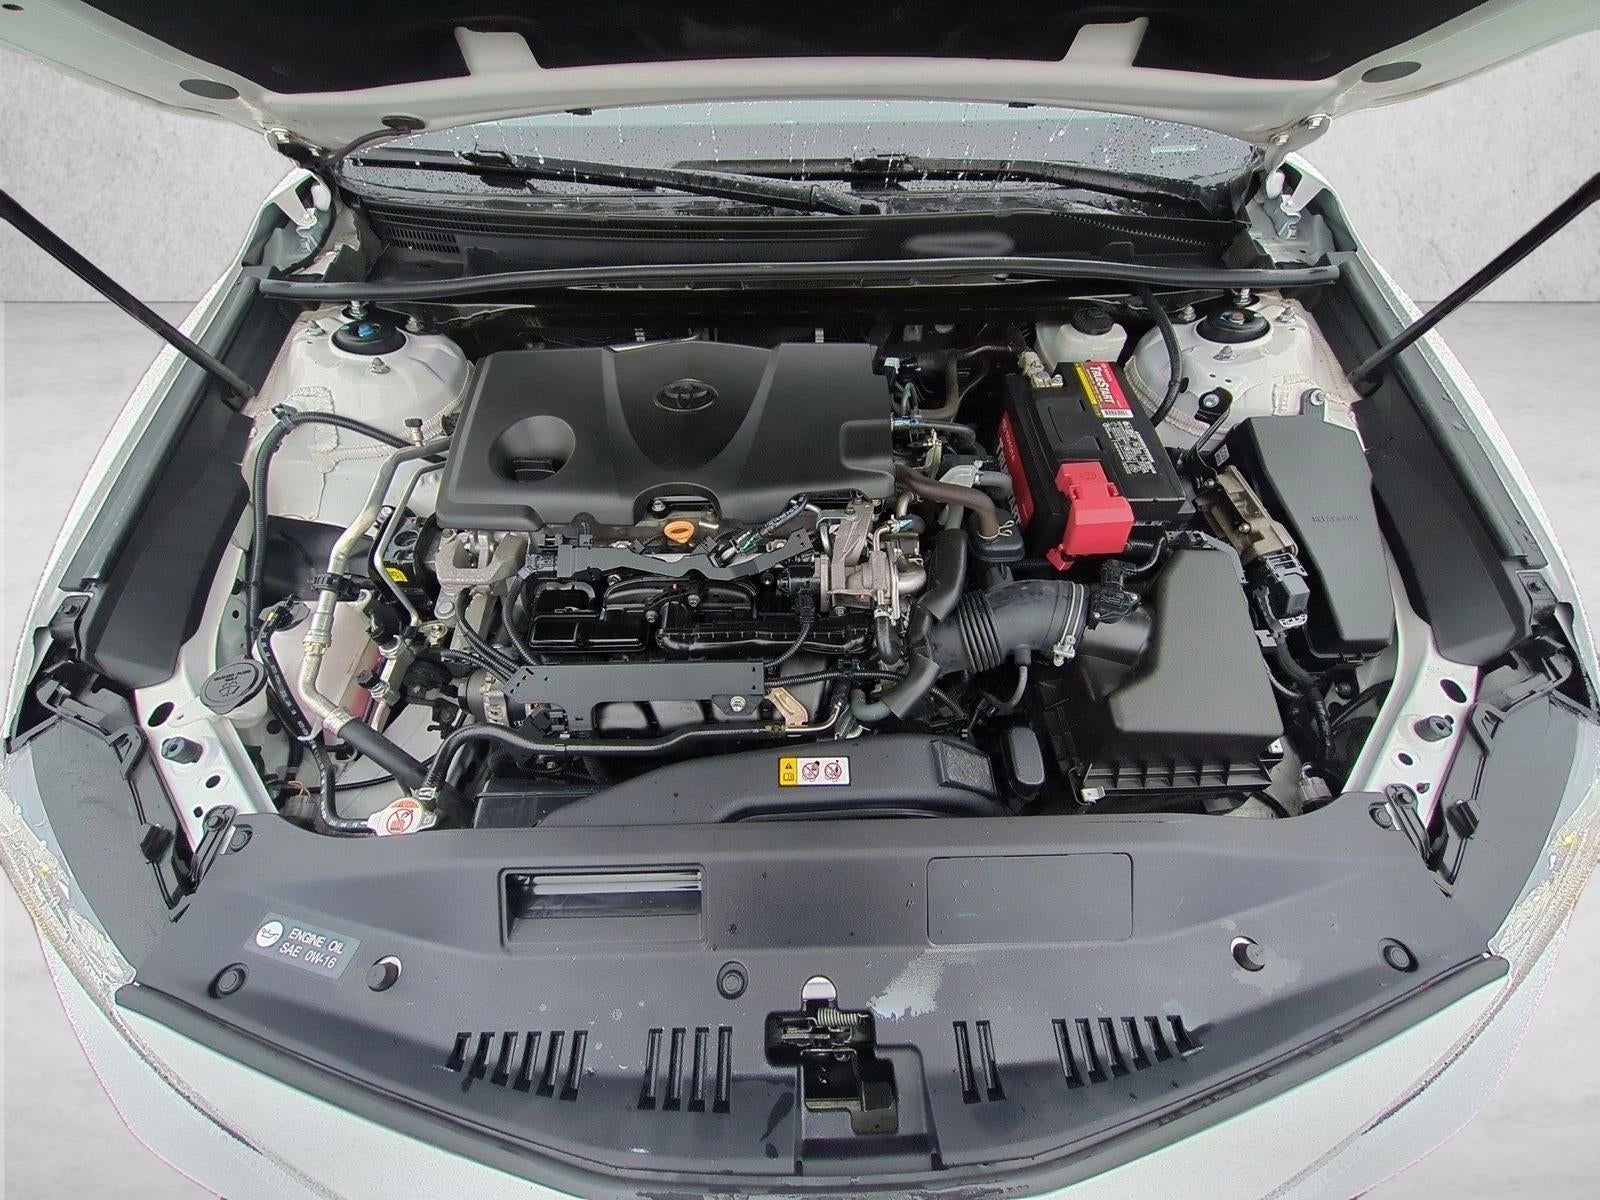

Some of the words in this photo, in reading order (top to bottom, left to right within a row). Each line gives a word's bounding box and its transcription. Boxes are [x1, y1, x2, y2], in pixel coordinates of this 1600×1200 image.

[289, 928, 326, 947] ENGINE
[328, 941, 345, 954] OIL
[279, 942, 303, 958] SAE
[304, 951, 337, 968] 0W-16
